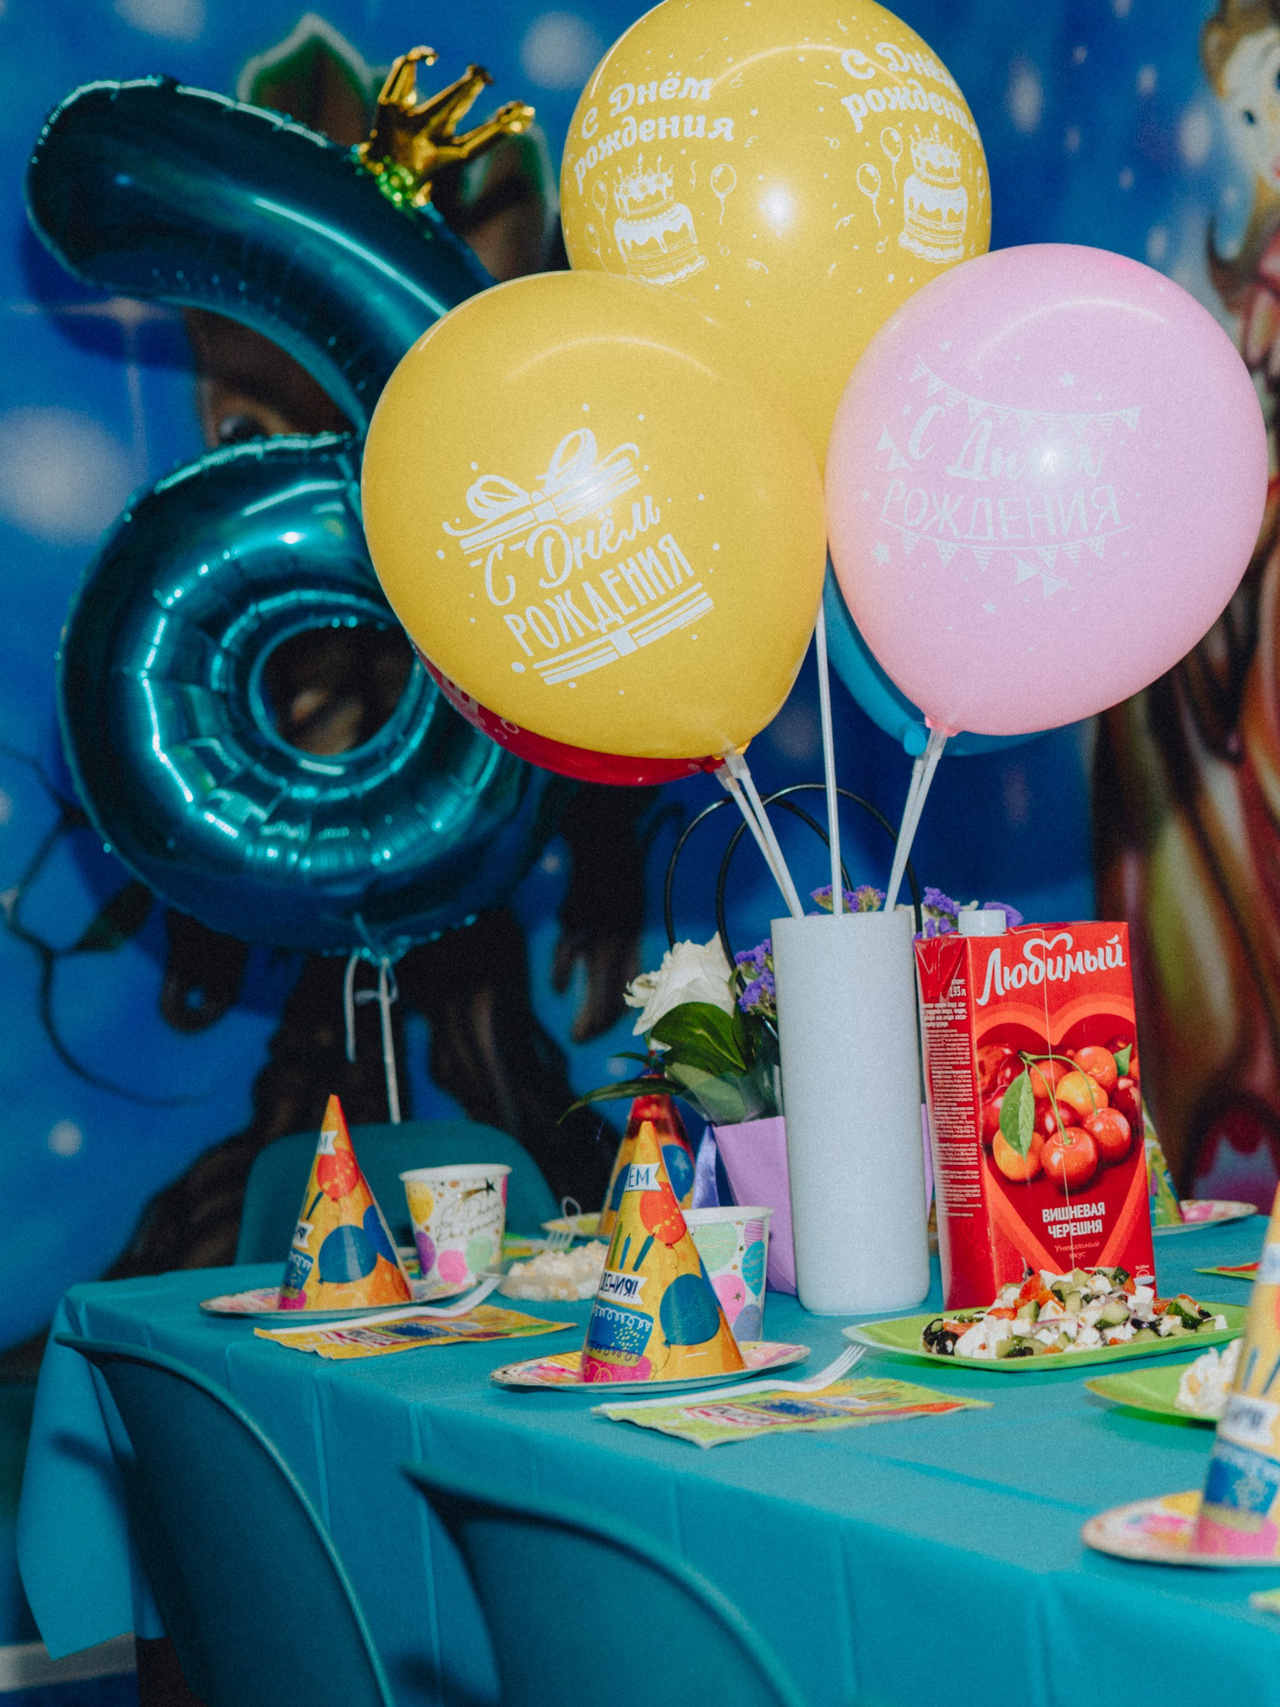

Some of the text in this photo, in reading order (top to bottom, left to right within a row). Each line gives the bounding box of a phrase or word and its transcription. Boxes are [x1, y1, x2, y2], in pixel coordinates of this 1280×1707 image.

[841, 48, 876, 80] С
[581, 71, 714, 140] С Днём
[574, 114, 735, 197] рождения
[907, 403, 1105, 482] С Днм
[881, 477, 1122, 540] РОЖДЕНИЯ
[484, 495, 661, 606] С Днём
[503, 533, 695, 657] РОЖДЕНИЯ
[975, 932, 1127, 1006] Любимый
[1041, 1201, 1106, 1223] ВИШНЕВАЯ
[1047, 1219, 1103, 1239] ЧЕРЕШНЯ
